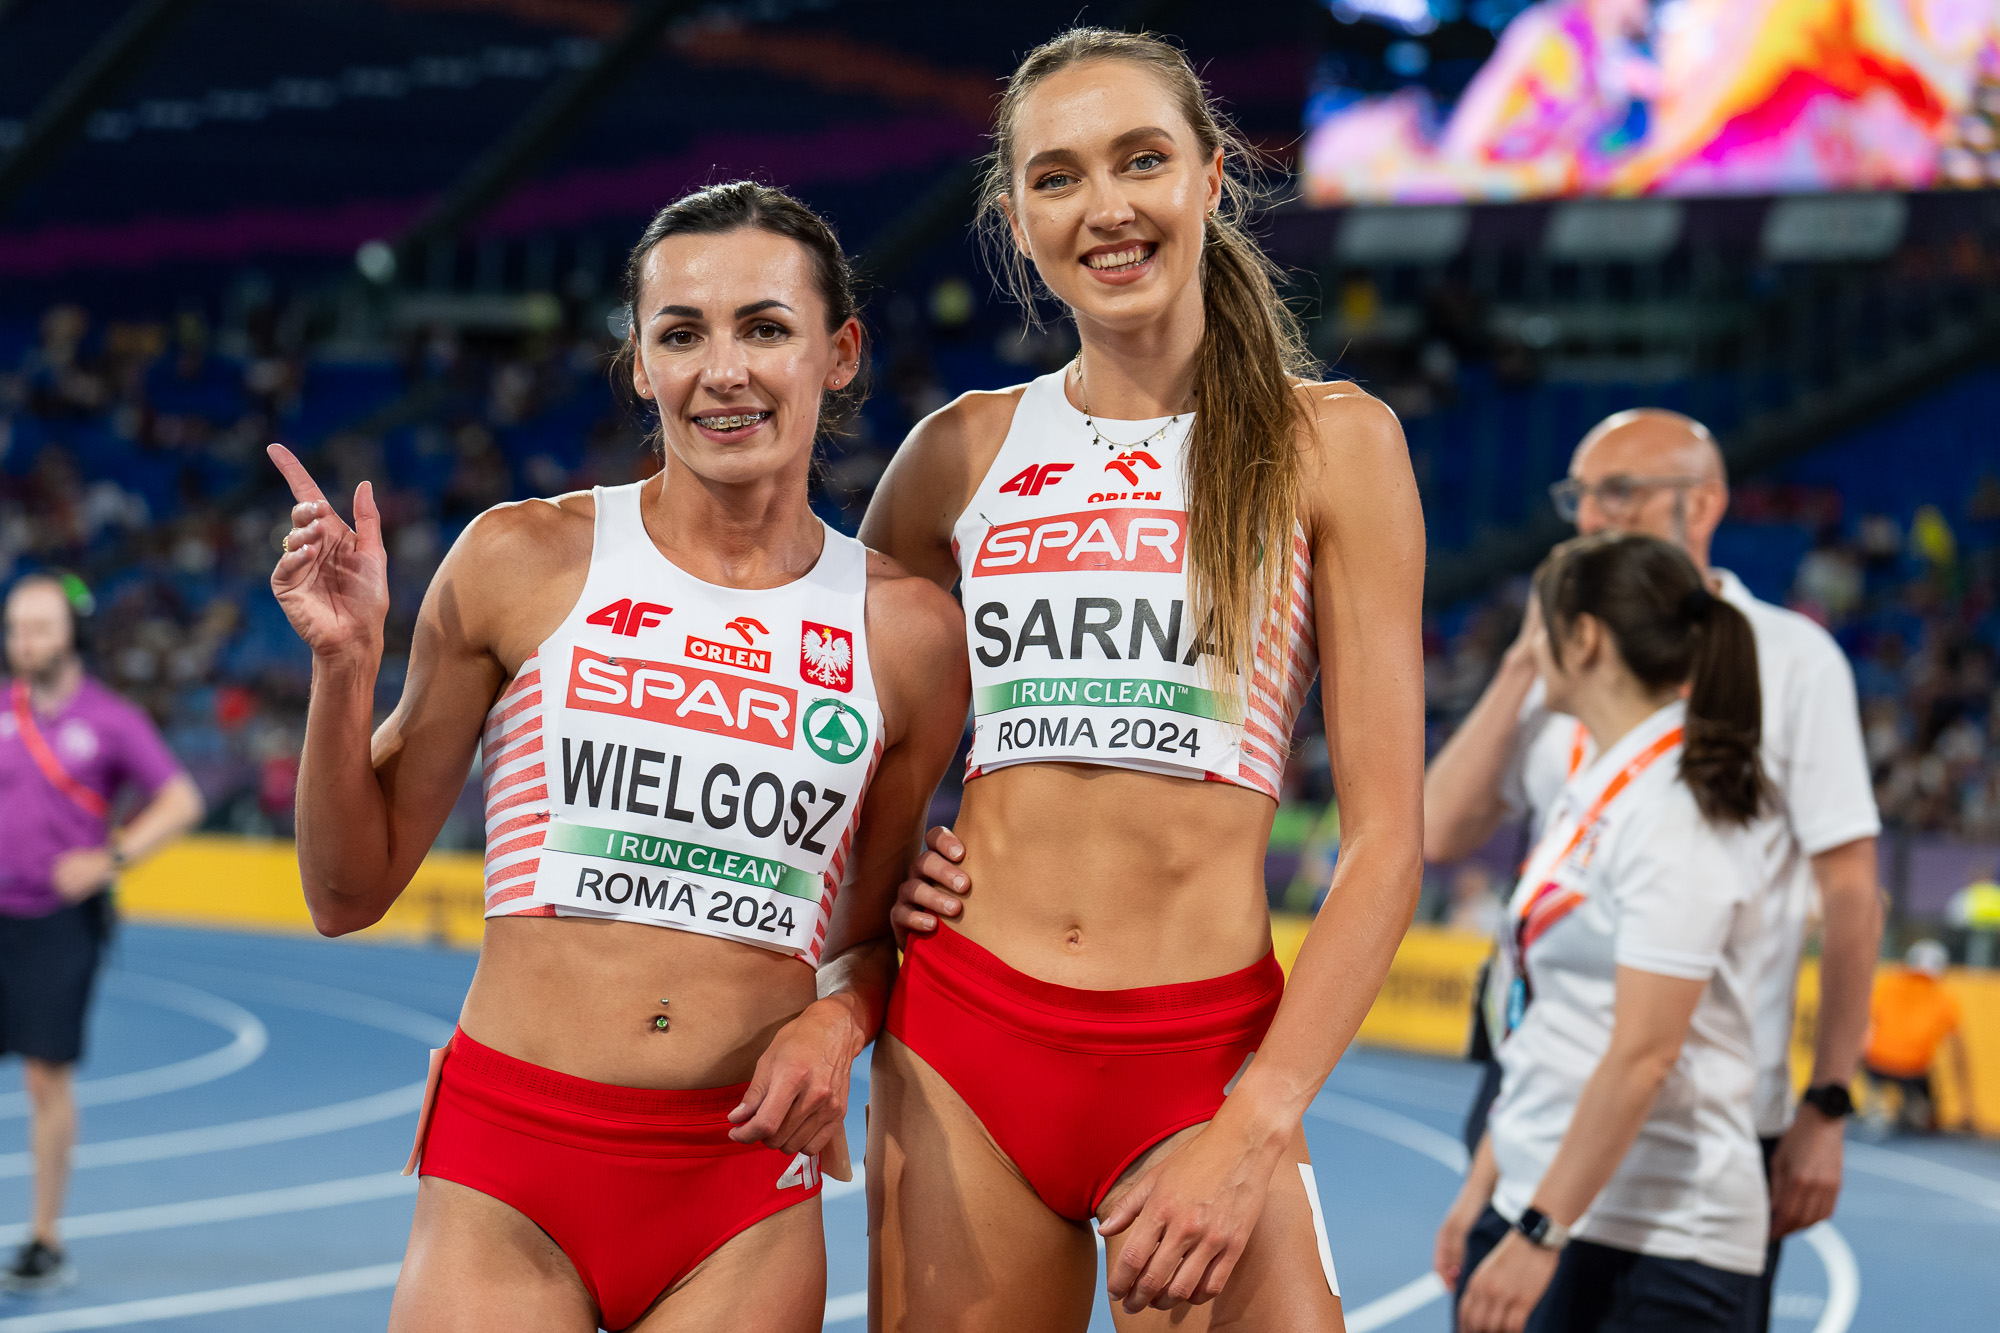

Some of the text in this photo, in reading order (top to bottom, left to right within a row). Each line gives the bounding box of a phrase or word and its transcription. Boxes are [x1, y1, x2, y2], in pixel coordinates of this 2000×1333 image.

[999, 463, 1075, 497] 4F
[981, 517, 1180, 568] SPAR
[586, 598, 673, 637] 4F
[974, 597, 1240, 675] SARNA
[690, 640, 766, 669] ORLEN
[575, 657, 791, 738] SPAR
[1012, 682, 1018, 704] I
[1021, 681, 1078, 703] RUN
[997, 716, 1201, 758] ROMA 2024
[562, 737, 847, 856] WIELGOSZ
[606, 833, 614, 854] I
[621, 836, 682, 866] RUN
[576, 868, 796, 937] ROMA 2024
